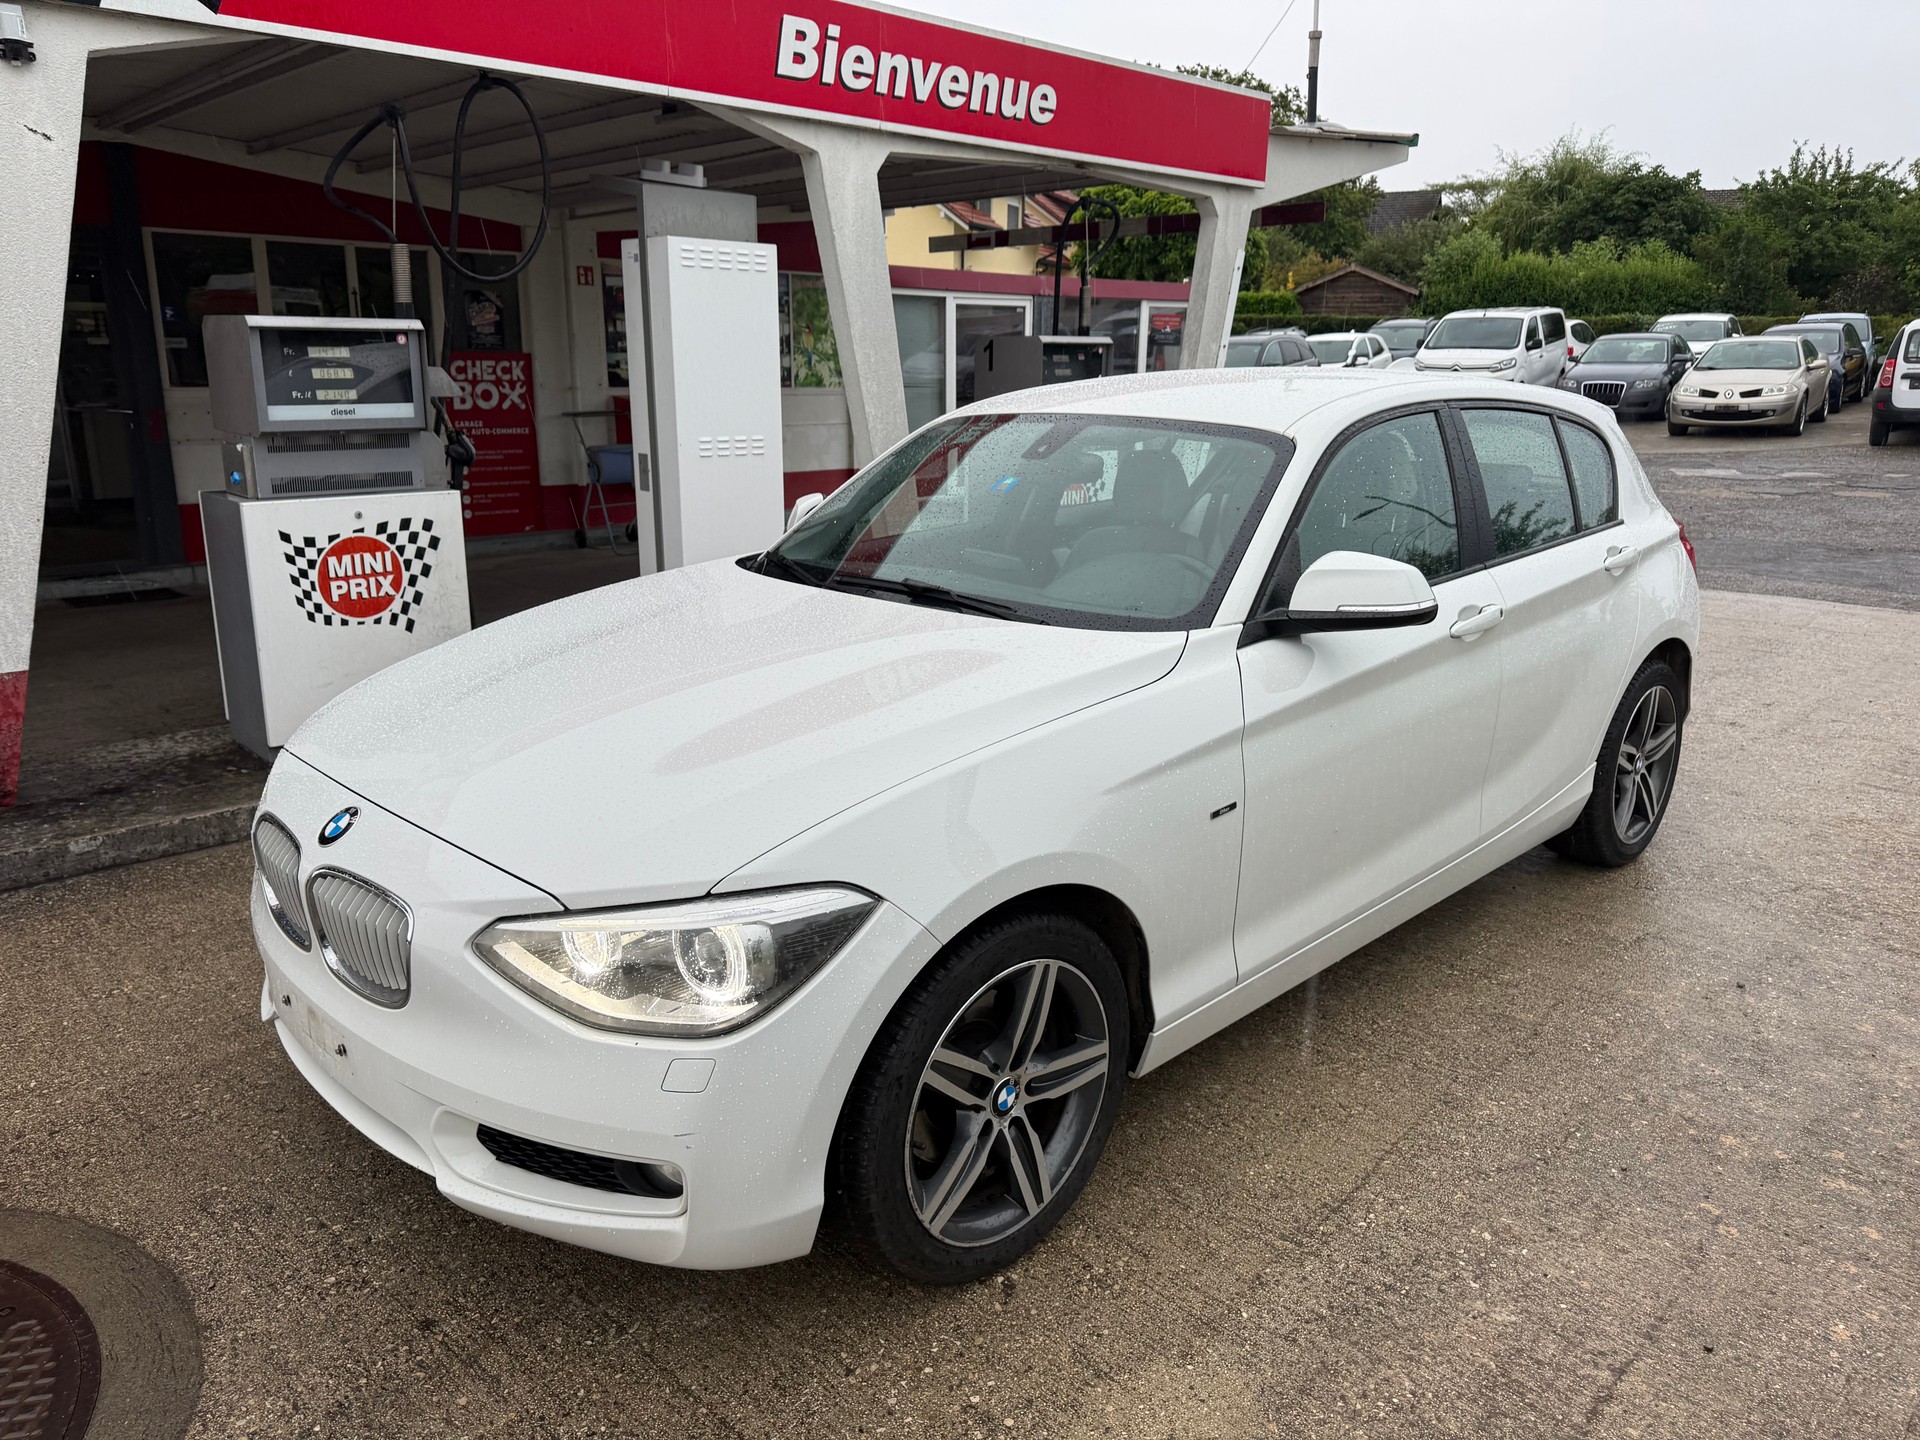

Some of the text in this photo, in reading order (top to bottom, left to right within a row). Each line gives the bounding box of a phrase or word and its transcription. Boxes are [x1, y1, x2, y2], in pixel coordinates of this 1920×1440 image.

[775, 14, 1058, 125] Bienvenue
[983, 339, 994, 372] 1
[450, 360, 526, 381] CHECK
[452, 381, 527, 411] BOX
[330, 407, 356, 416] diesel
[455, 420, 484, 428] GARAGE
[471, 427, 530, 436] AUTO-COMMERCE
[326, 550, 394, 579] MINI
[329, 574, 398, 603] PRIX
